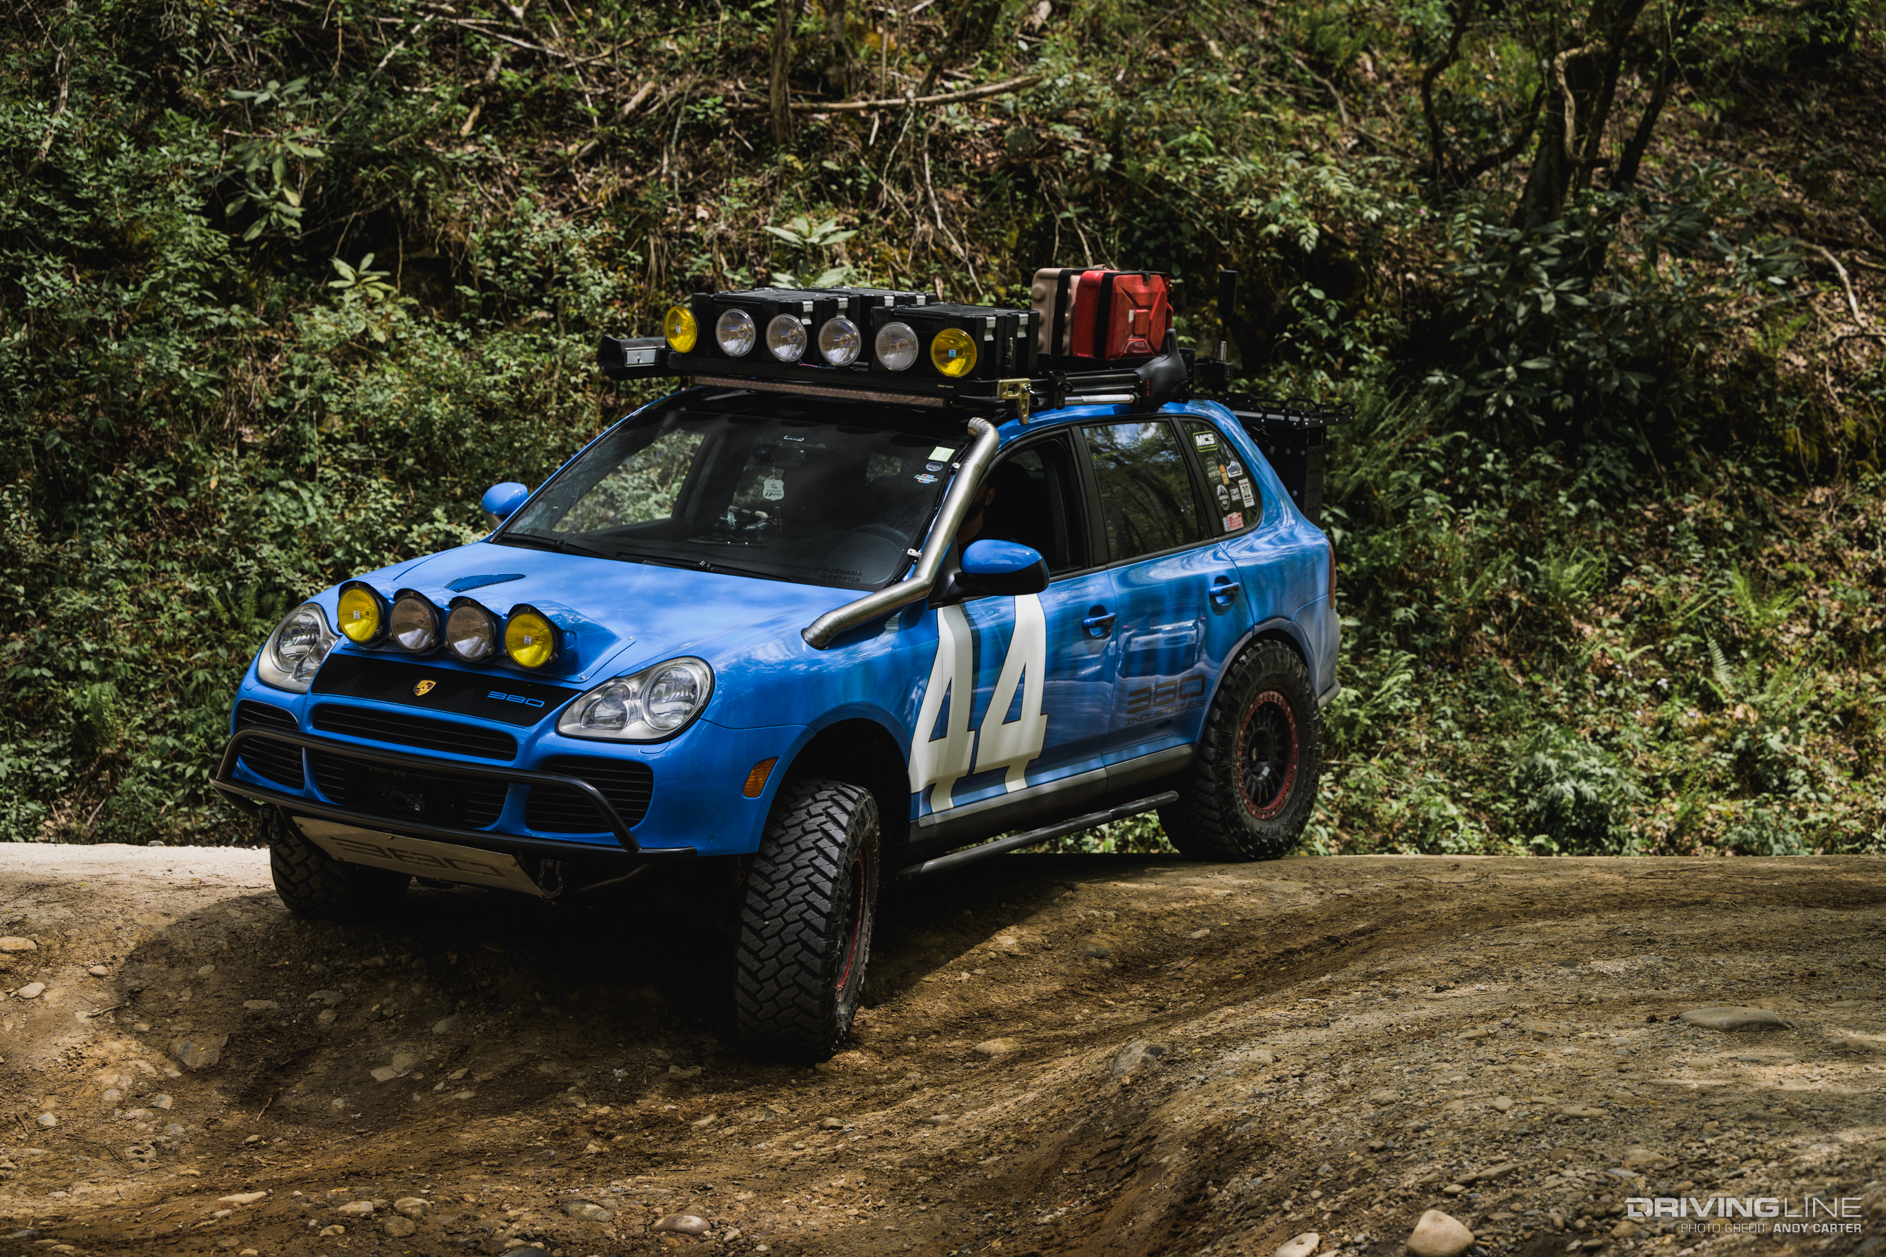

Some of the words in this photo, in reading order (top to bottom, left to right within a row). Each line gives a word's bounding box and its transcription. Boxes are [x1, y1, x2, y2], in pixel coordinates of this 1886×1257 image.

[1195, 433, 1215, 447] MCS
[487, 691, 545, 708] 380
[908, 593, 1048, 814] 44
[1126, 673, 1206, 715] 380
[1124, 699, 1206, 727] INDUSTRIES
